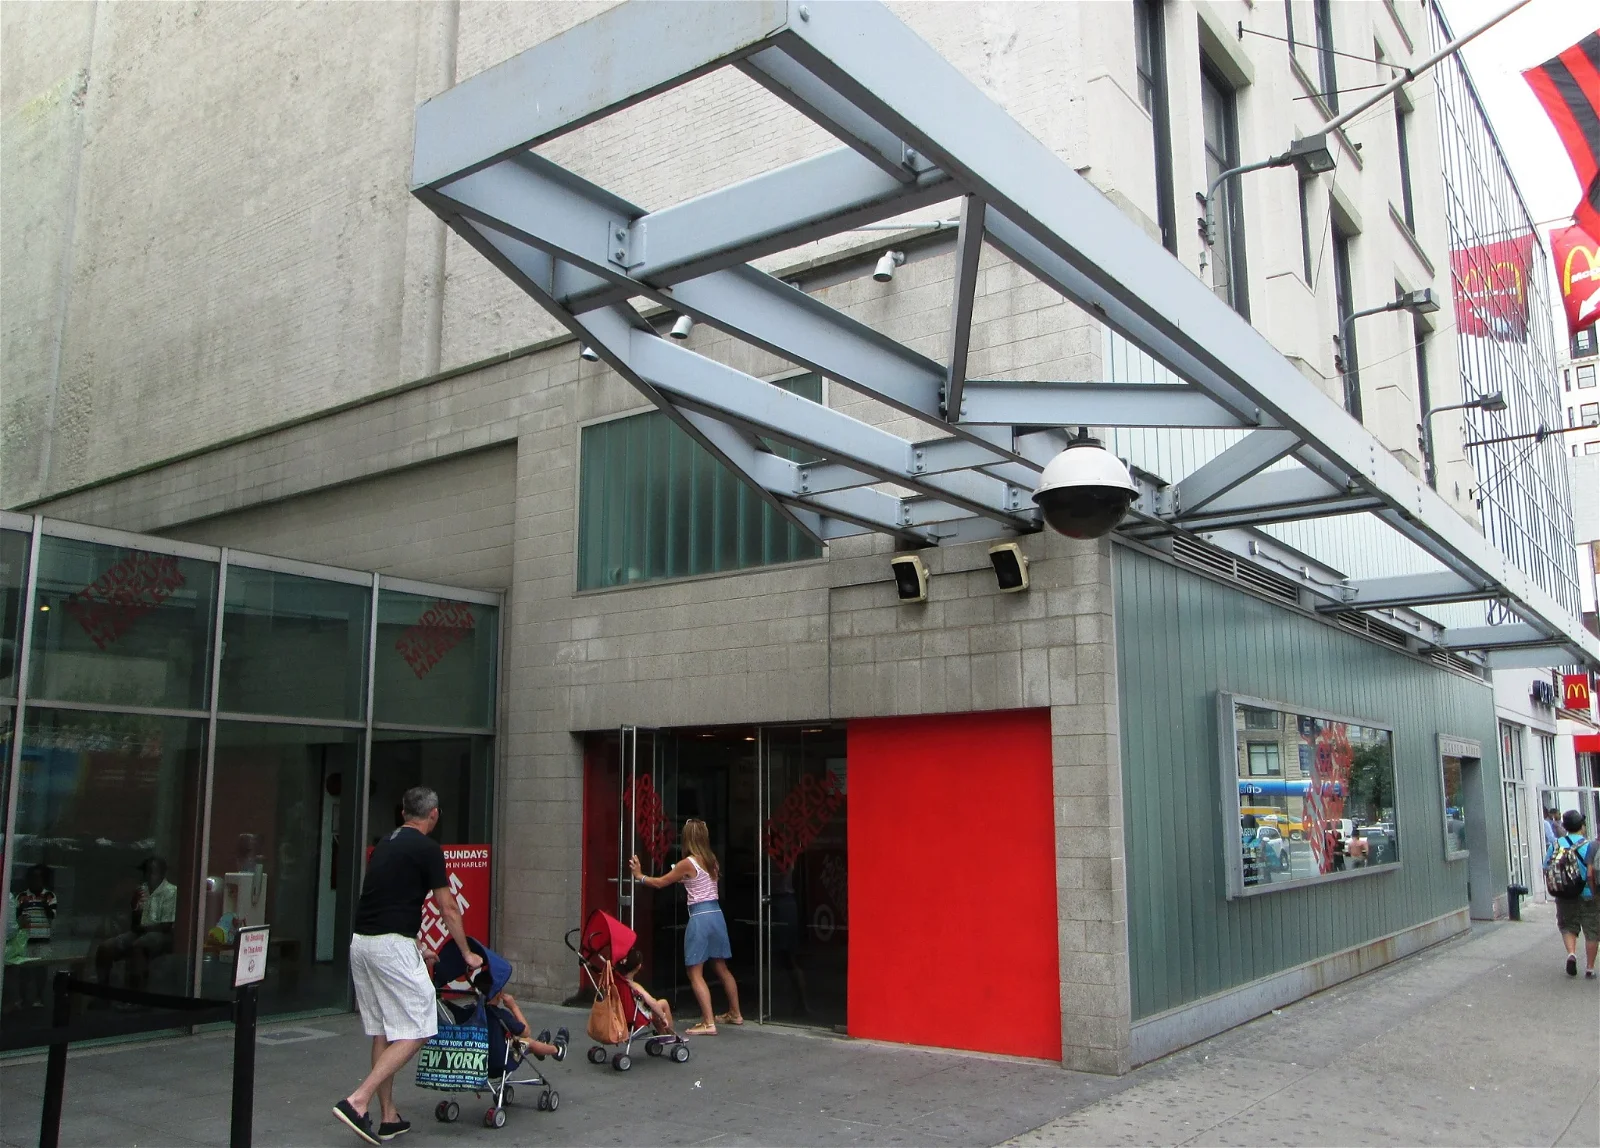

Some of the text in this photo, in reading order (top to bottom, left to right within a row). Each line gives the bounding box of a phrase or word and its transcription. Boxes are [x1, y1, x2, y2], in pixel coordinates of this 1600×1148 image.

[444, 850, 488, 859] SUNDAYS
[419, 1050, 486, 1071] EW YORK
